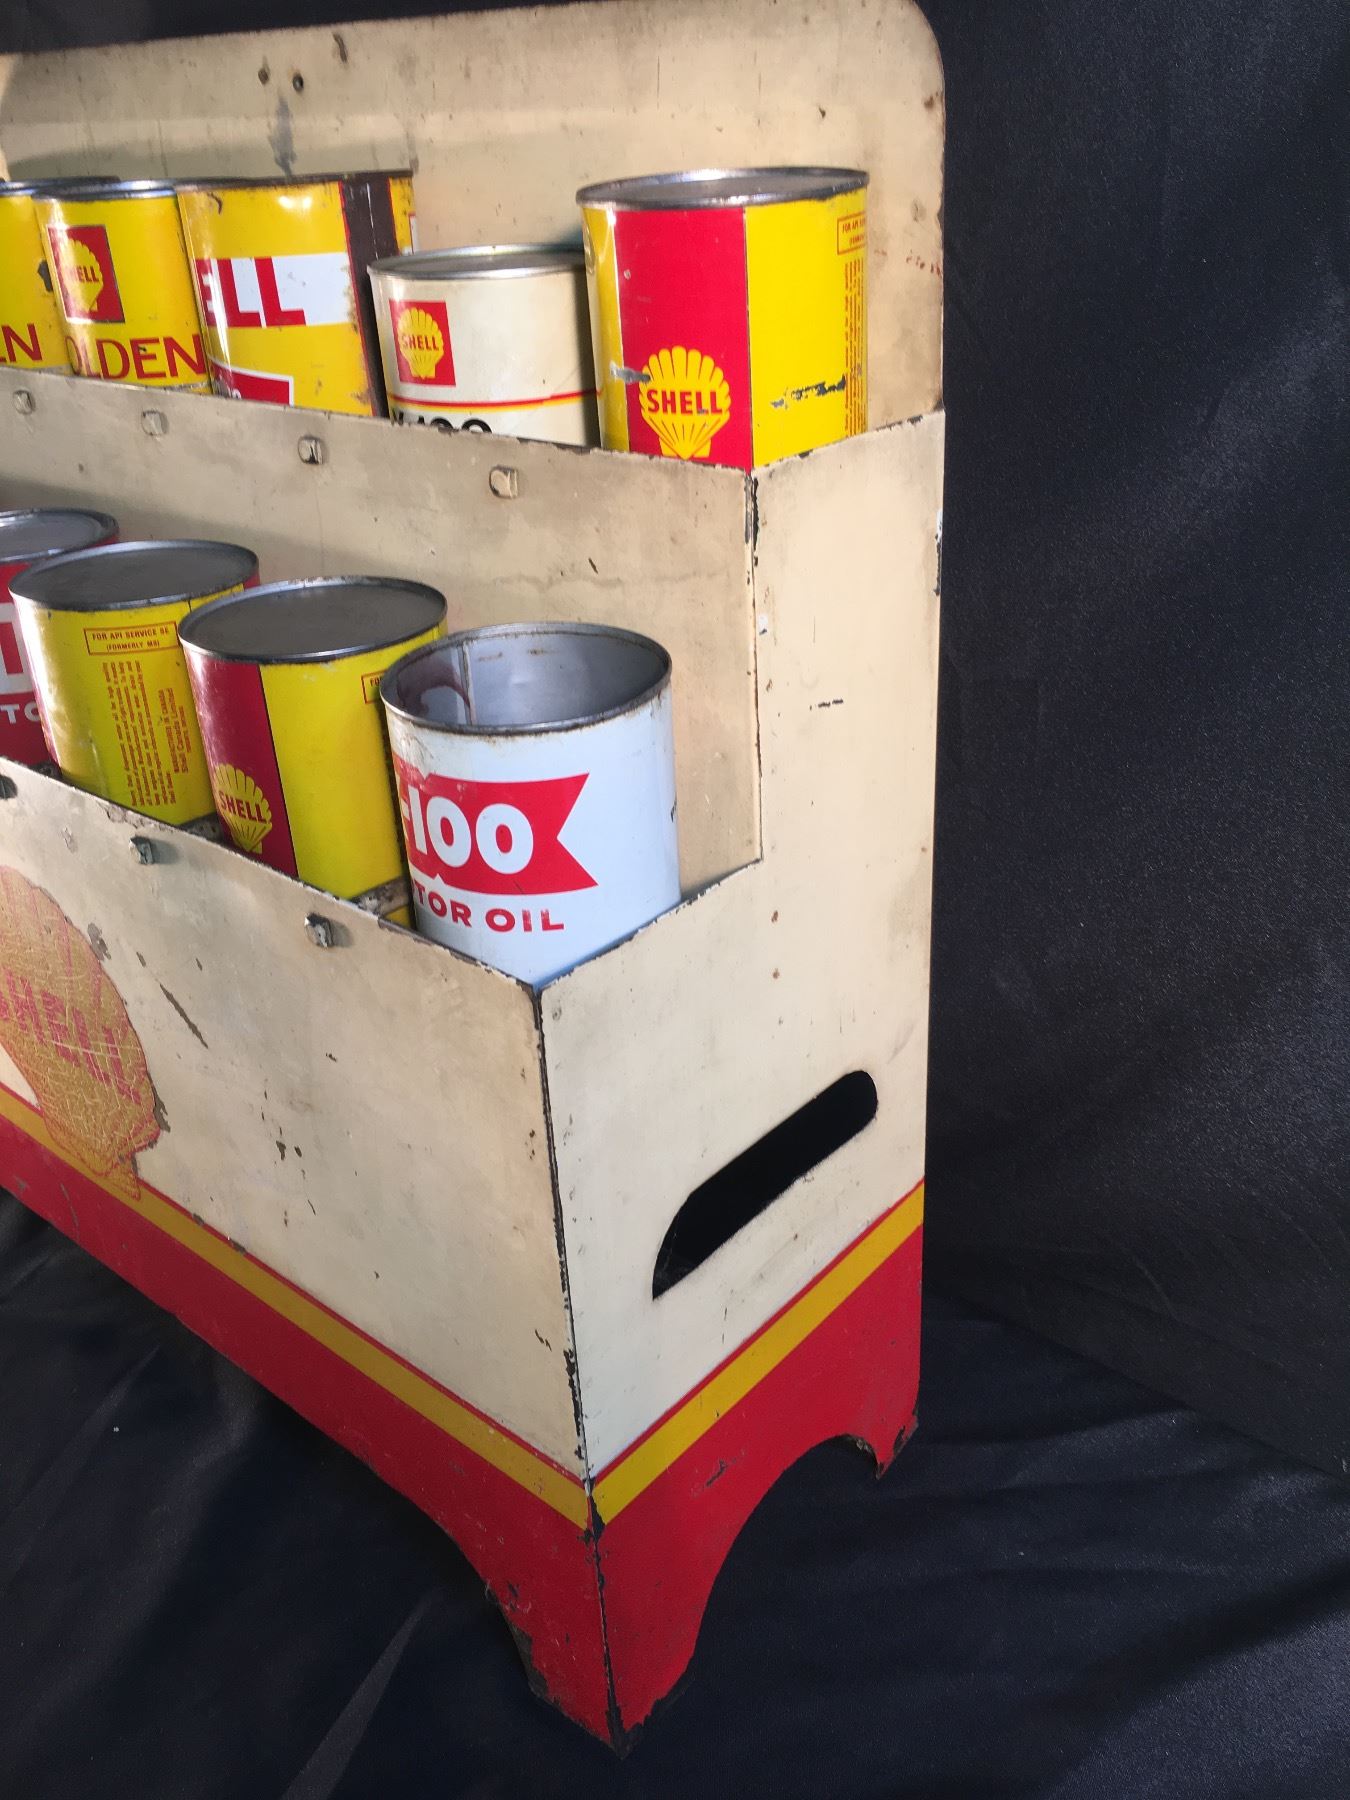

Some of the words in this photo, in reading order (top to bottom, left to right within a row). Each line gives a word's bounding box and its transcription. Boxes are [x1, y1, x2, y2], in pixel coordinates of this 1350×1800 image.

[0, 323, 43, 363] N
[401, 334, 440, 351] SHELL
[646, 389, 722, 415] SHELL
[92, 632, 108, 641] FOR
[110, 631, 123, 640] API
[125, 629, 157, 640] SERVICE
[370, 677, 382, 687] FO
[219, 790, 268, 824] SHELL
[485, 908, 564, 933] OIL
